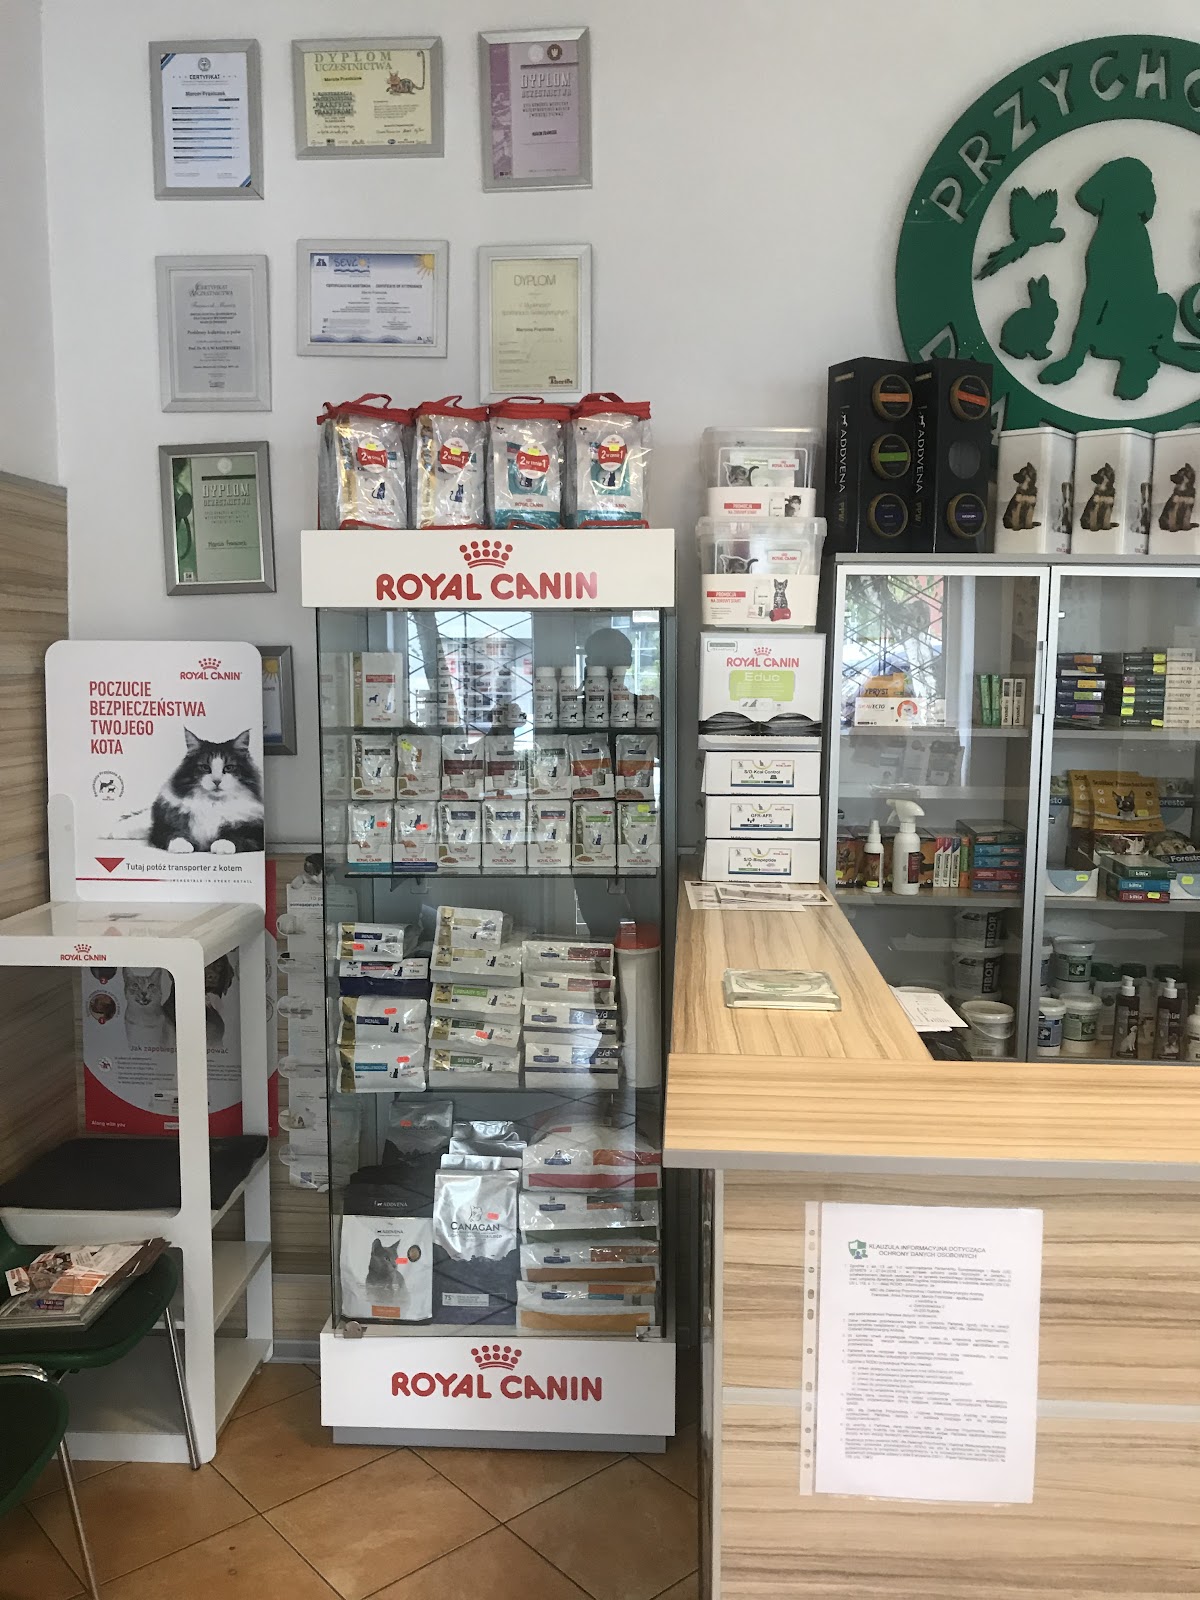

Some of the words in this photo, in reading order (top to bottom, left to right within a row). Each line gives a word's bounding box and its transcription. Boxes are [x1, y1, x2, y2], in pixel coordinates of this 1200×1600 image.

[315, 51, 392, 63] DYPLOM
[315, 61, 393, 72] UCZESTNICTWA
[520, 72, 571, 89] DYPLOM
[513, 274, 556, 287] DYPLOM
[361, 452, 368, 461] 2
[380, 454, 385, 463] 1
[442, 450, 449, 460] 2
[461, 455, 465, 464] 1
[600, 450, 606, 459] 2
[619, 450, 624, 459] 1
[520, 456, 526, 465] 2
[541, 459, 547, 468] 1
[839, 429, 847, 493] ADDVENA
[916, 429, 925, 494] ADDVENA
[202, 483, 250, 498] DYPLOM
[376, 573, 482, 601] ROYAL
[490, 571, 598, 600] CANIN
[726, 657, 760, 667] ROYAL
[763, 658, 800, 668] CANIN
[180, 672, 209, 681] ROYAL
[210, 672, 242, 681] CANIN
[744, 672, 780, 682] Educ
[89, 681, 152, 697] POCZUCIE
[863, 688, 889, 697] YPRYST
[89, 698, 207, 717] BEZPIECZEŃSTWA
[90, 720, 154, 736] TWOJEGO
[90, 739, 123, 755] KOTA
[126, 863, 145, 873] Tutaj
[146, 862, 167, 874] połóż
[168, 863, 212, 873] transporter
[218, 864, 243, 872] kotem
[986, 915, 998, 947] FIBOR
[983, 961, 995, 993] FIBOR
[130, 1044, 142, 1052] Jak
[91, 1120, 106, 1129] Along
[450, 1221, 500, 1231] CANAGAN
[868, 1243, 900, 1251] KLAUZULA
[948, 1246, 986, 1254] DOTYCZĄCA
[391, 1372, 492, 1398] ROYAL
[500, 1375, 602, 1402] CANIN
